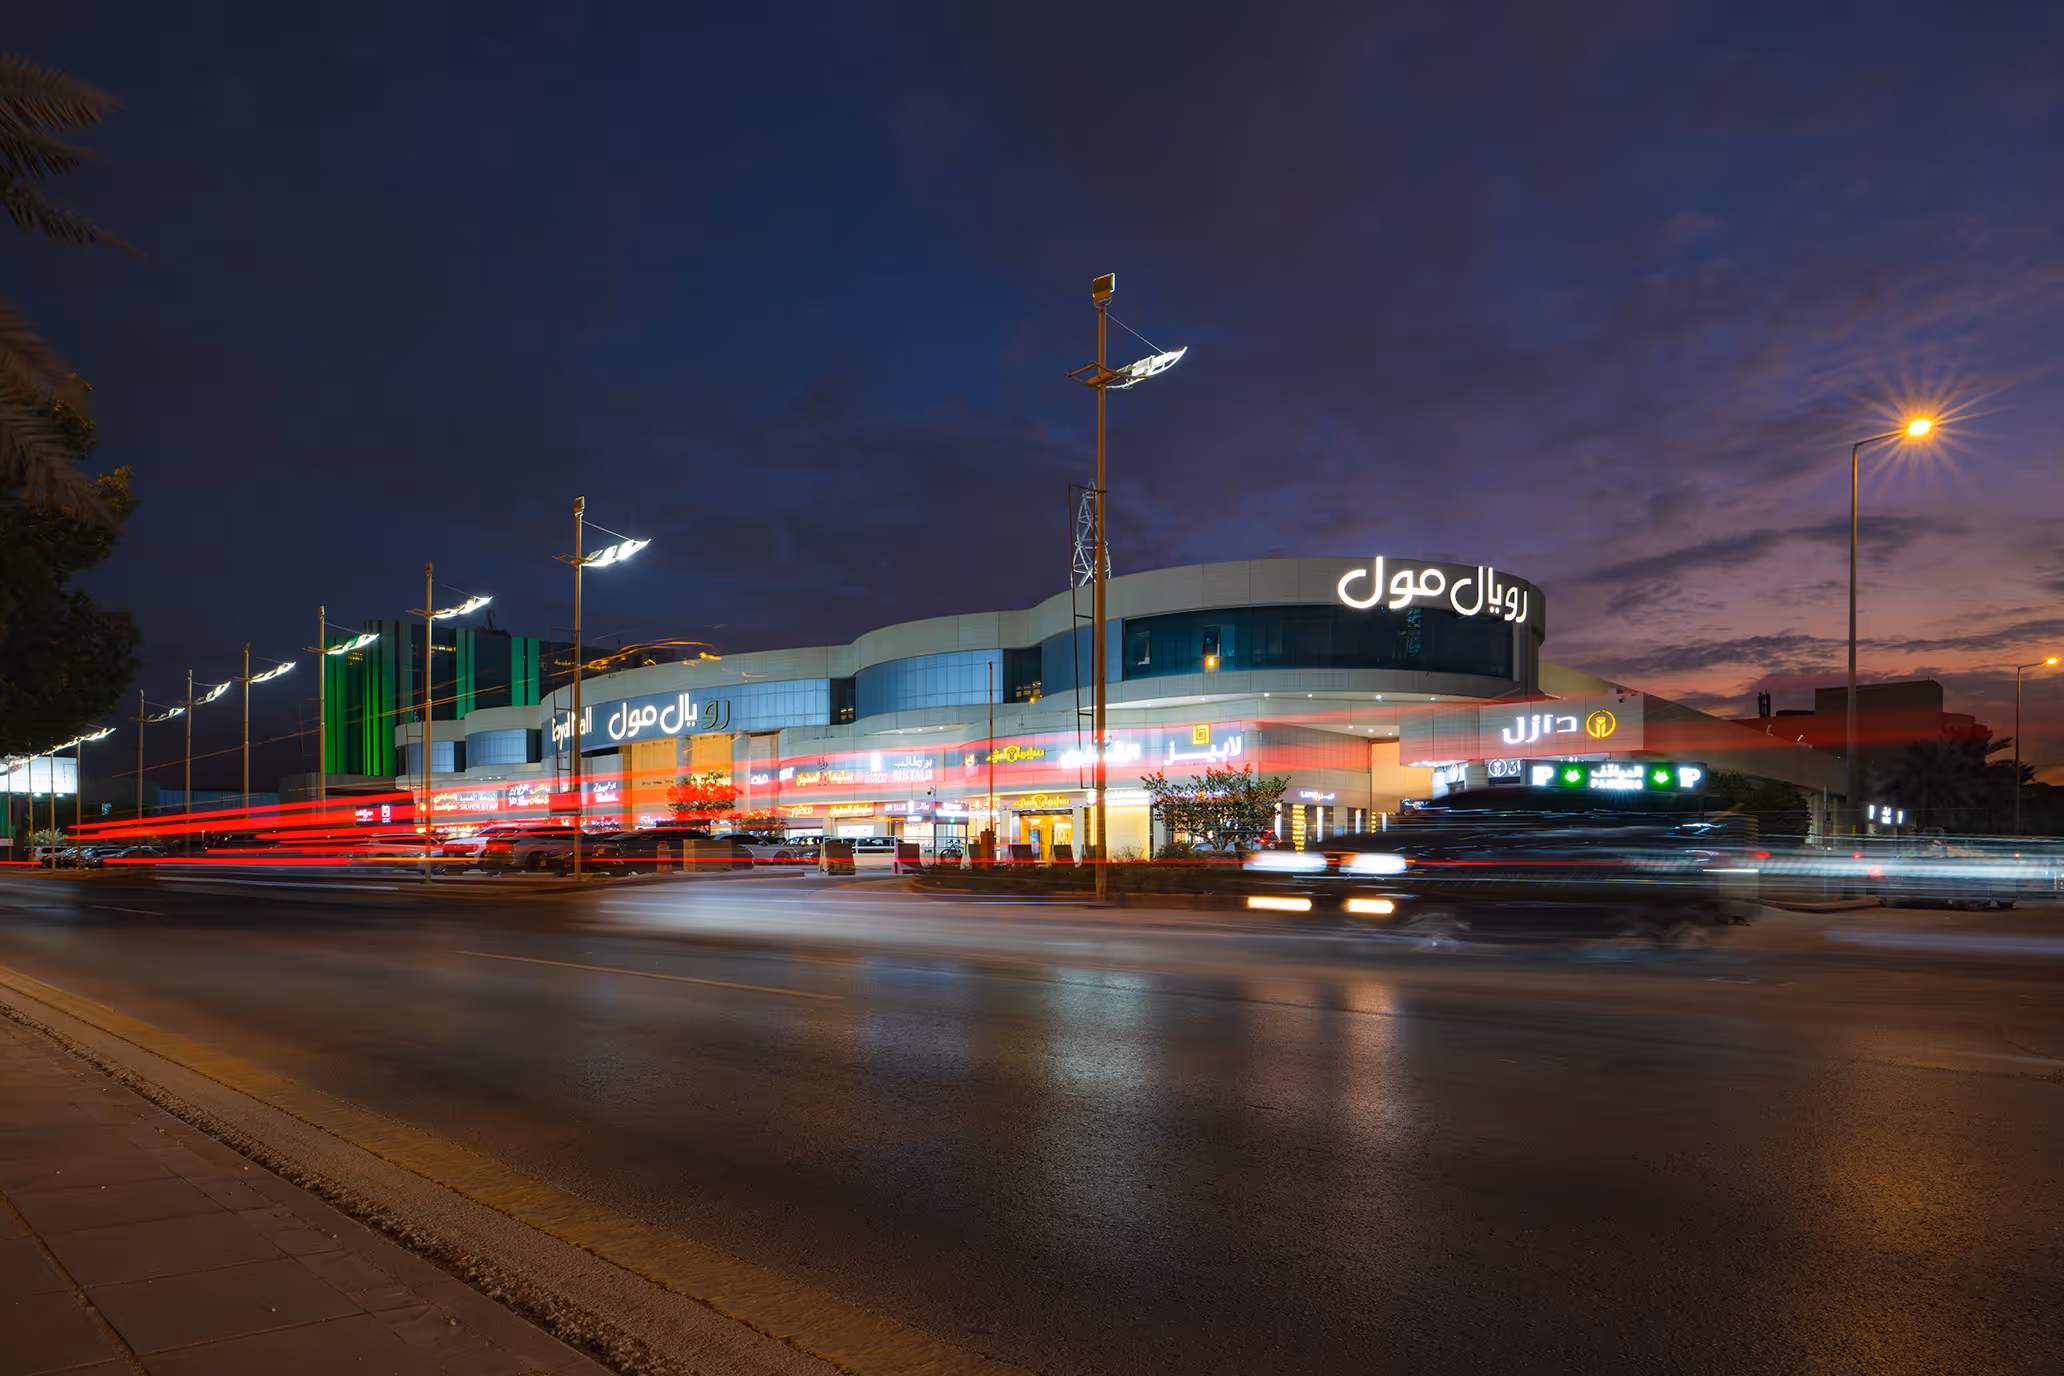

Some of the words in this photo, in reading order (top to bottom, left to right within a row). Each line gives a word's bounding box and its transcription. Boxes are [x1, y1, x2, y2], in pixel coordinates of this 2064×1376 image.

[1337, 556, 1446, 610] مول
[1450, 566, 1528, 623] رويال
[608, 702, 658, 740] مول
[660, 693, 731, 734] رويال
[1501, 714, 1578, 744] دازل
[1533, 765, 1554, 785] P
[1679, 767, 1701, 787] P
